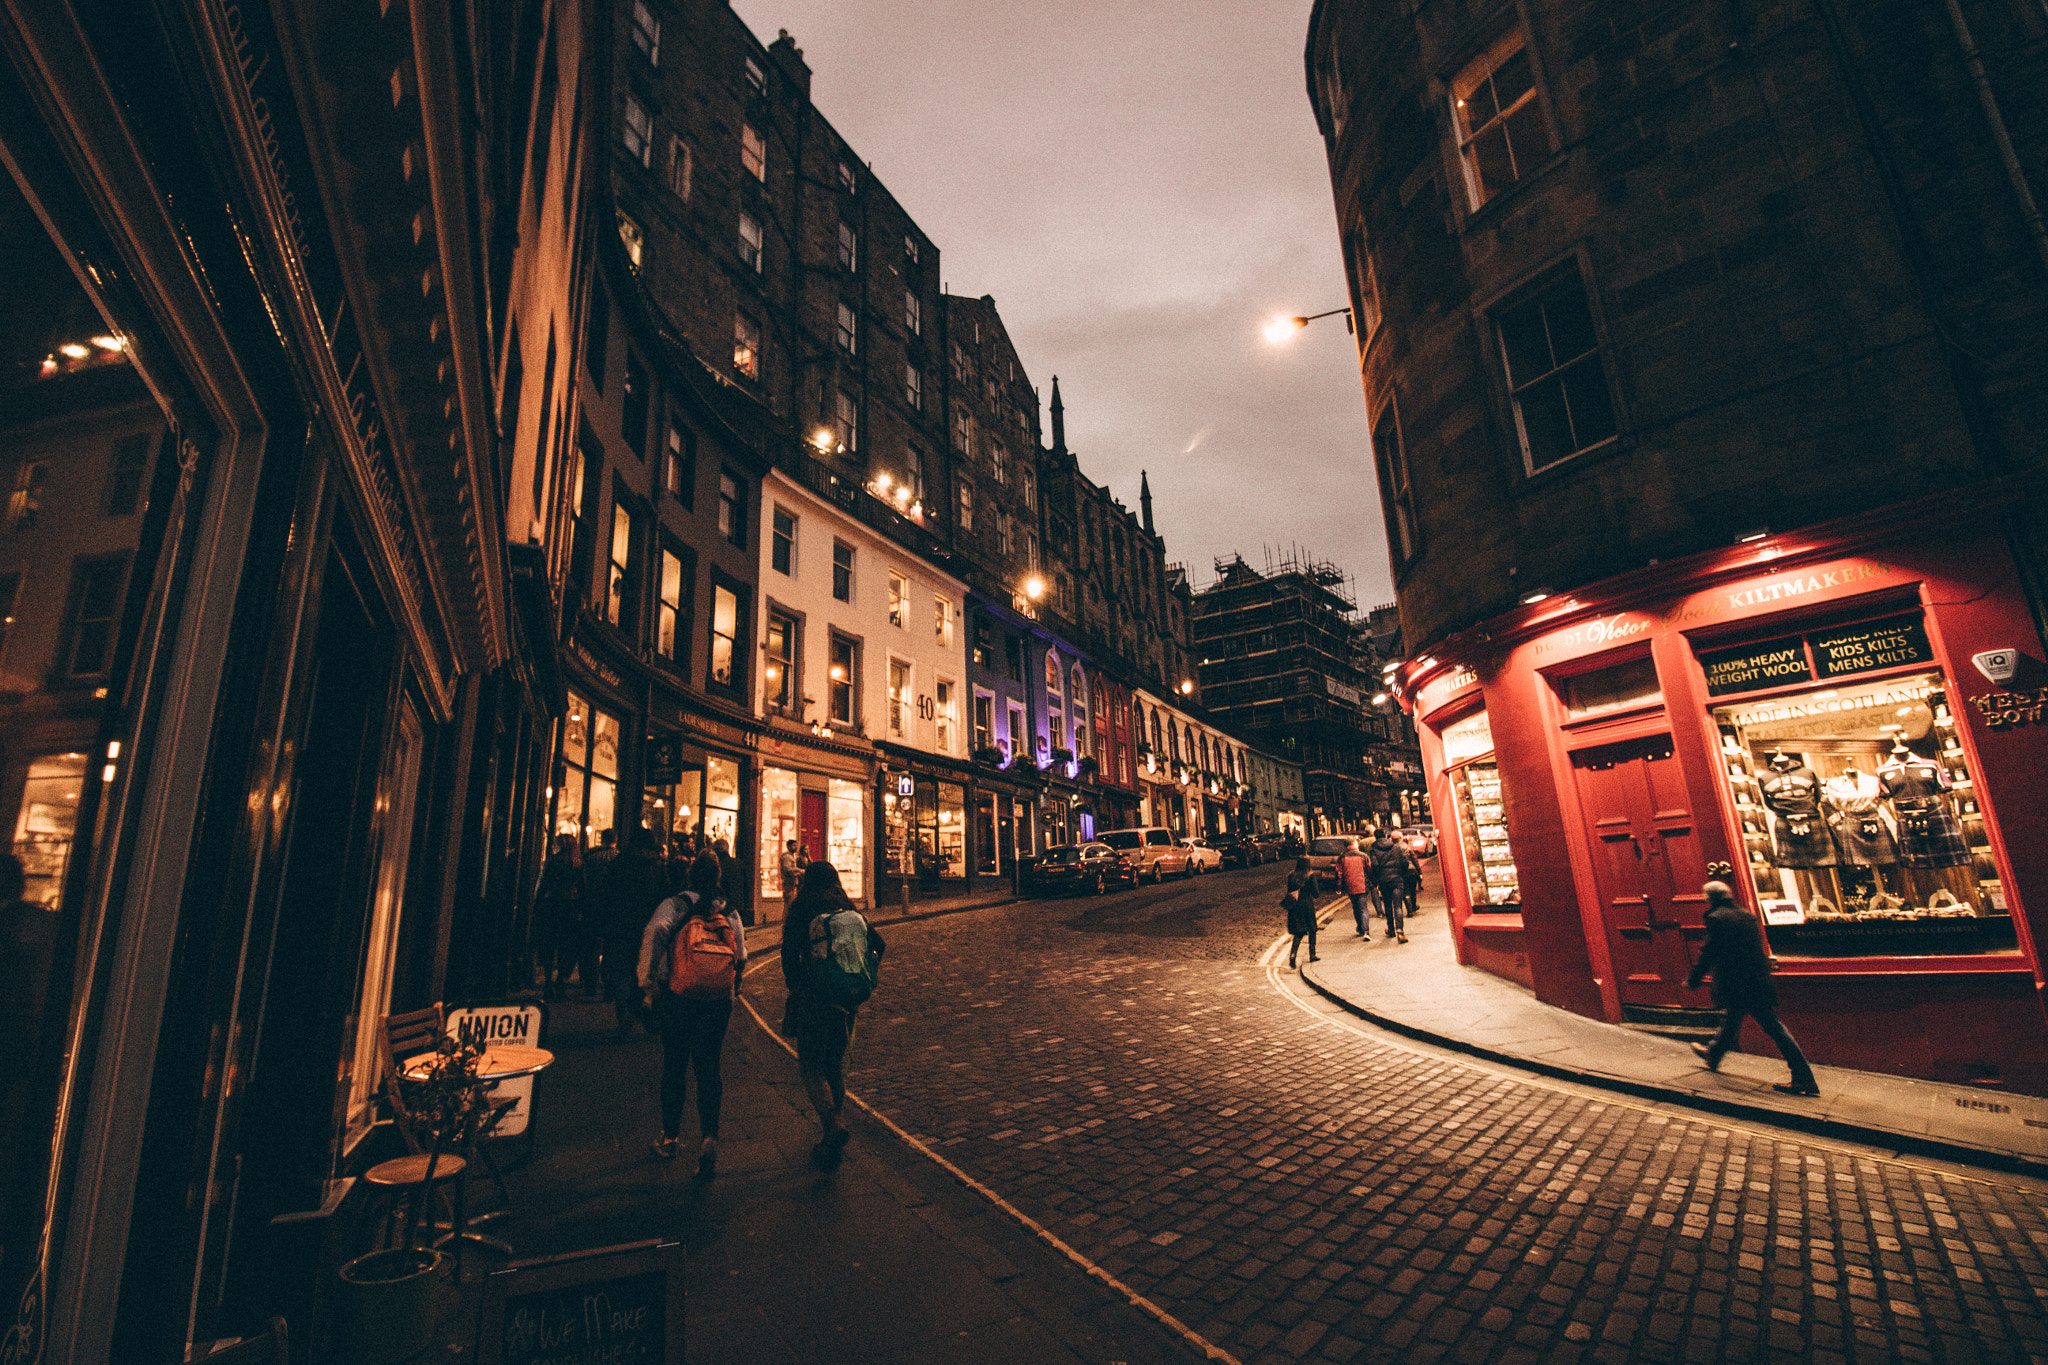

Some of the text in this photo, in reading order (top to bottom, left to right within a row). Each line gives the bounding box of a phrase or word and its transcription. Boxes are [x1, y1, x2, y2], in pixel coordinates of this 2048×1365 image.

[1587, 612, 1651, 644] Victor
[1659, 602, 1722, 630] Scott
[1729, 561, 1891, 609] KILTMAKERS
[1828, 647, 1919, 673] MENS KILTS
[1829, 635, 1908, 659] KIDS KILTS
[1706, 660, 1811, 687] WEIGHT WOOL
[1711, 649, 1797, 674] 100% HEAVY
[916, 694, 934, 721] 40
[1732, 687, 1930, 726] MADE IN SCOTLAND
[1982, 703, 2046, 726] BOW
[1799, 719, 1827, 736] TO
[901, 801, 910, 809] 20
[457, 1013, 530, 1040] UNION
